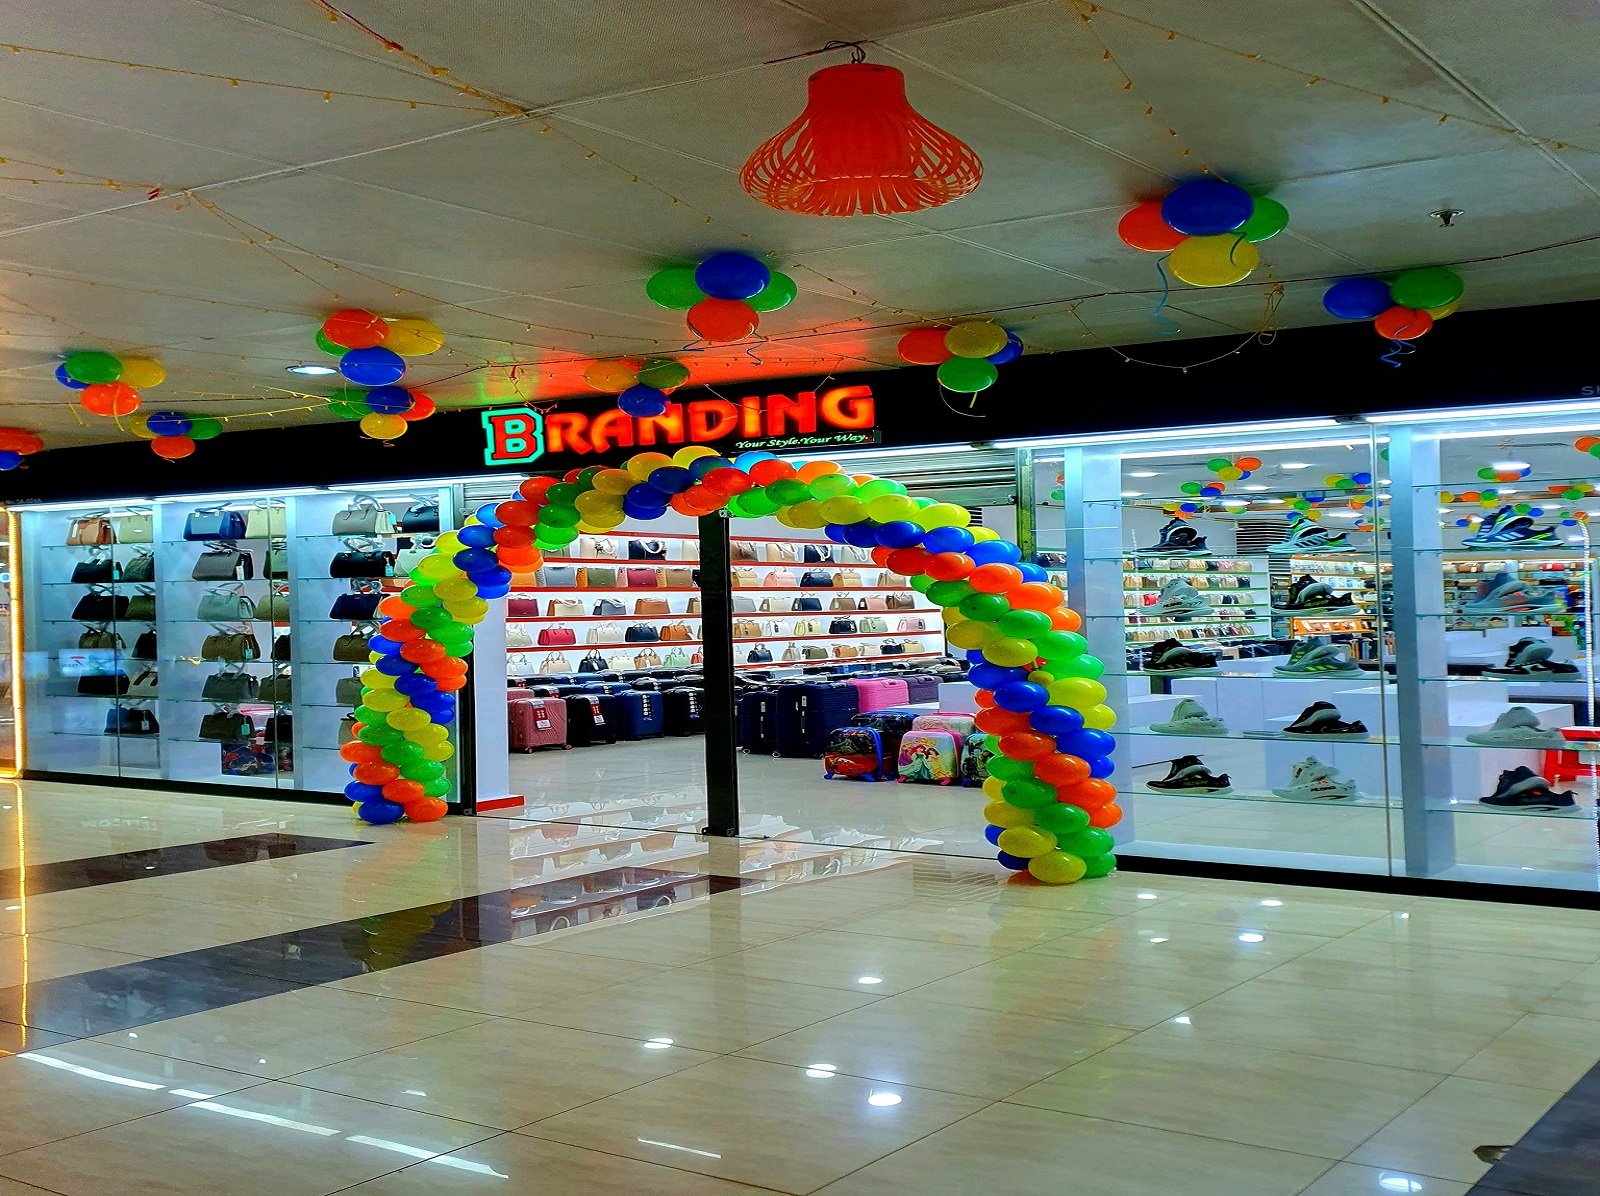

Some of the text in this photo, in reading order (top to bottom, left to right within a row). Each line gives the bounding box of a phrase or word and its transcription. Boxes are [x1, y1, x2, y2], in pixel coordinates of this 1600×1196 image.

[481, 385, 876, 466] BRANDING
[735, 440, 767, 449] Your
[833, 433, 869, 443] Way.
